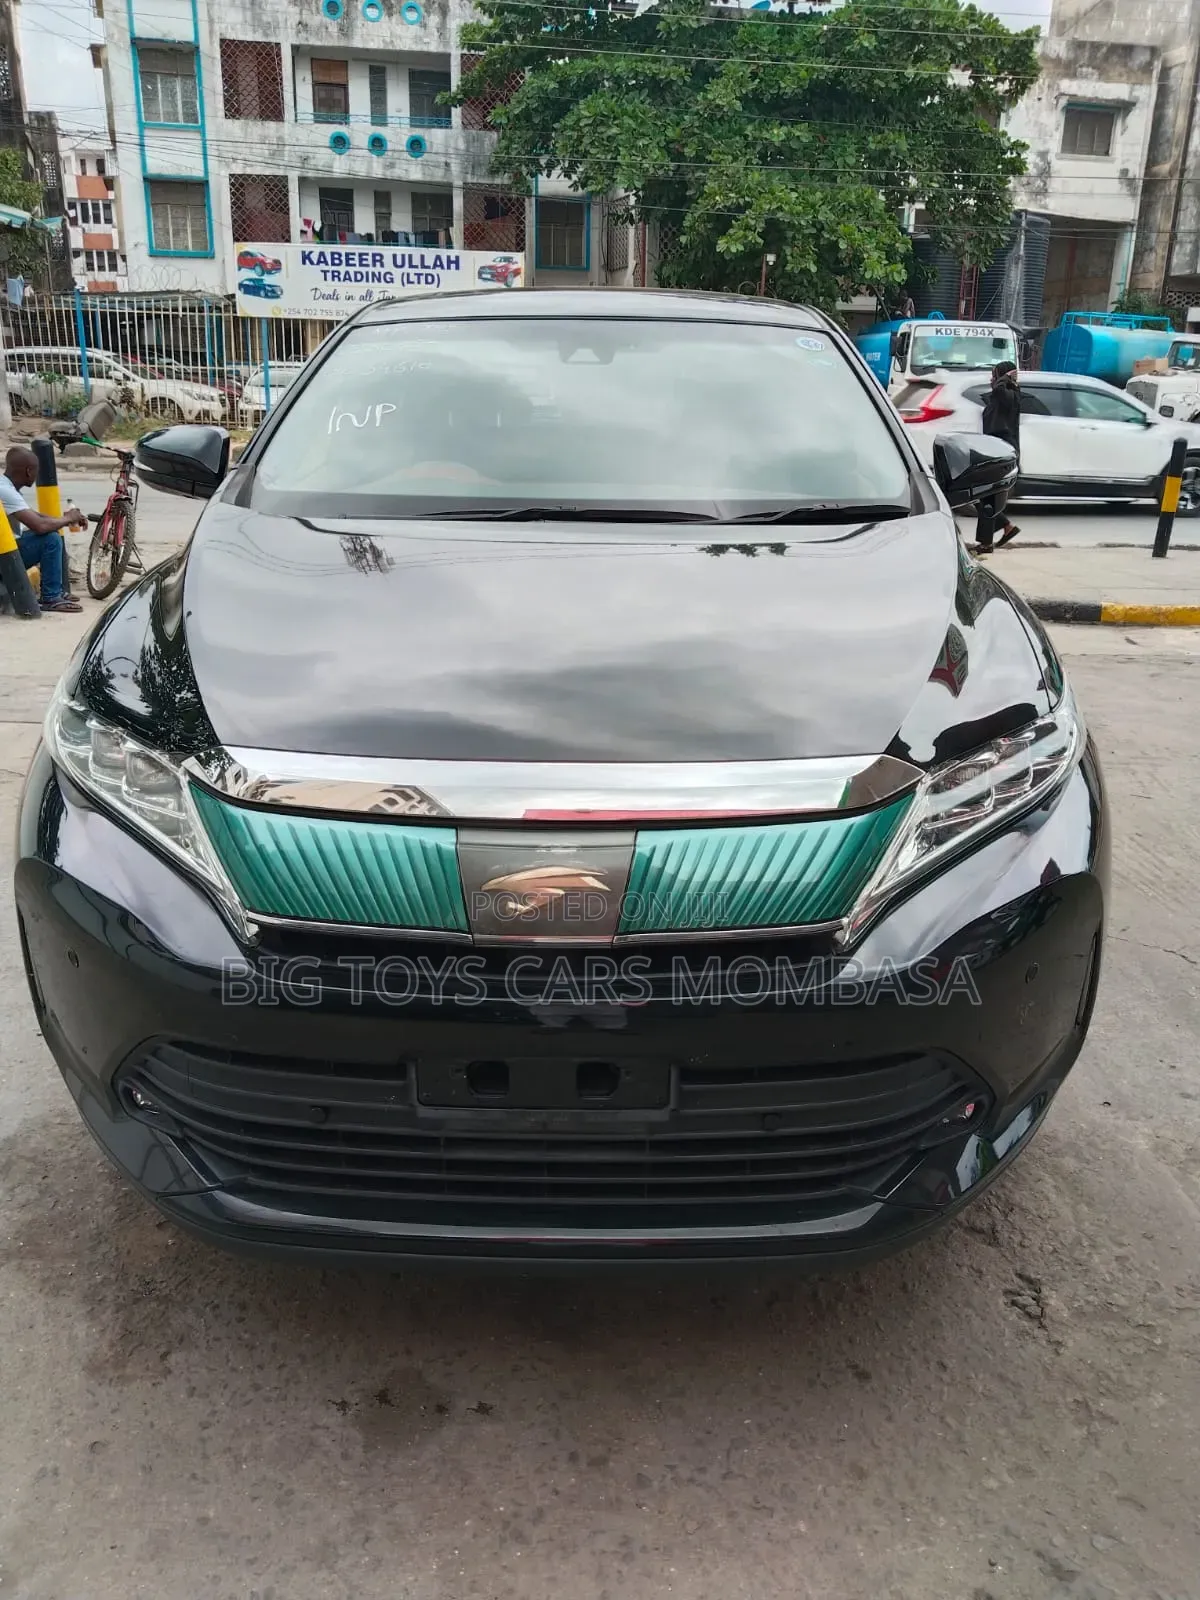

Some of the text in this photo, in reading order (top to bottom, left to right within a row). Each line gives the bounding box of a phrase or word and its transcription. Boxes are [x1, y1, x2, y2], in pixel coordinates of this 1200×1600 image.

[301, 250, 460, 271] KABEER ULLAH
[320, 269, 441, 288] TRADING (LTD)
[310, 287, 340, 301] Deals
[345, 291, 355, 301] in
[359, 289, 374, 302] all
[935, 327, 995, 337] KDE 794X
